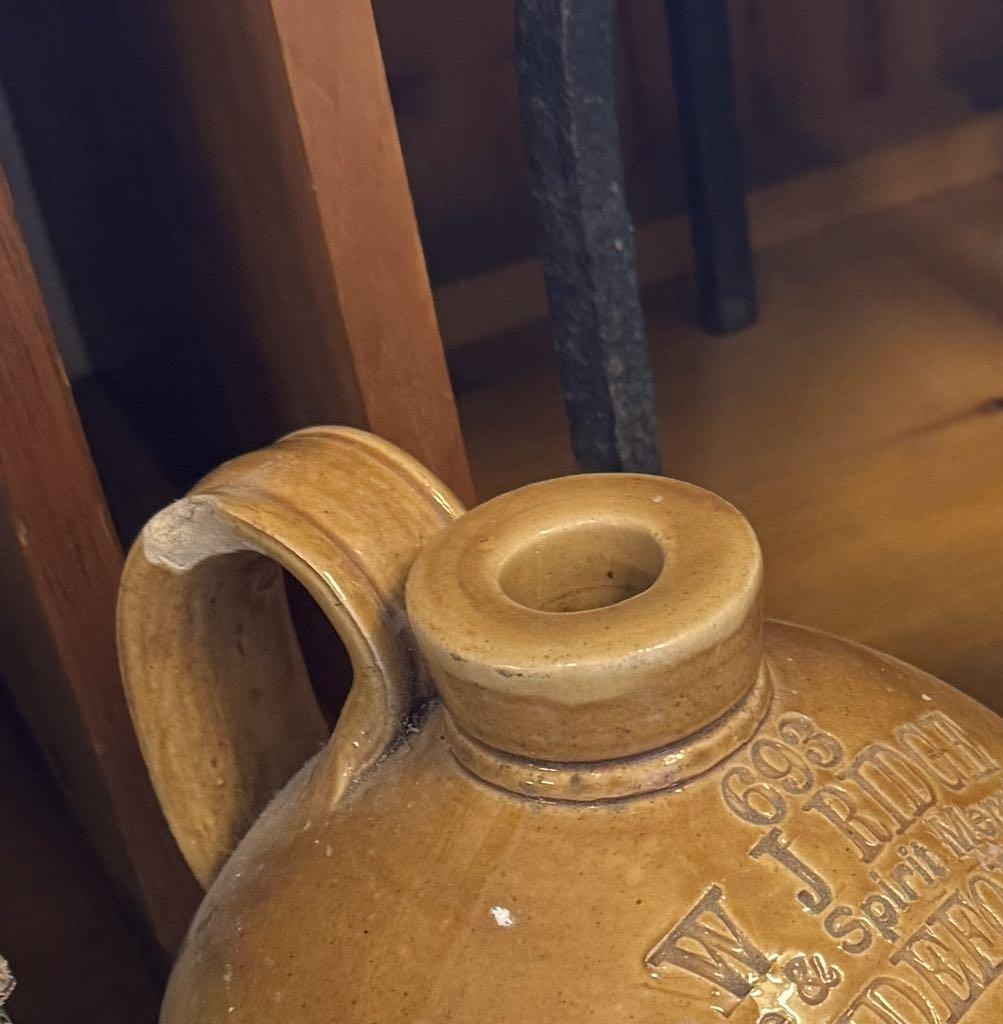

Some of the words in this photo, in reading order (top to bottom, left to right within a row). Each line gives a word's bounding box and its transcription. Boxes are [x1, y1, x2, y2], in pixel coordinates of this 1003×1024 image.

[721, 711, 845, 826] 693
[645, 884, 773, 1000] W
[749, 827, 833, 915] J
[784, 952, 843, 1006] &
[824, 841, 950, 955] Spirit
